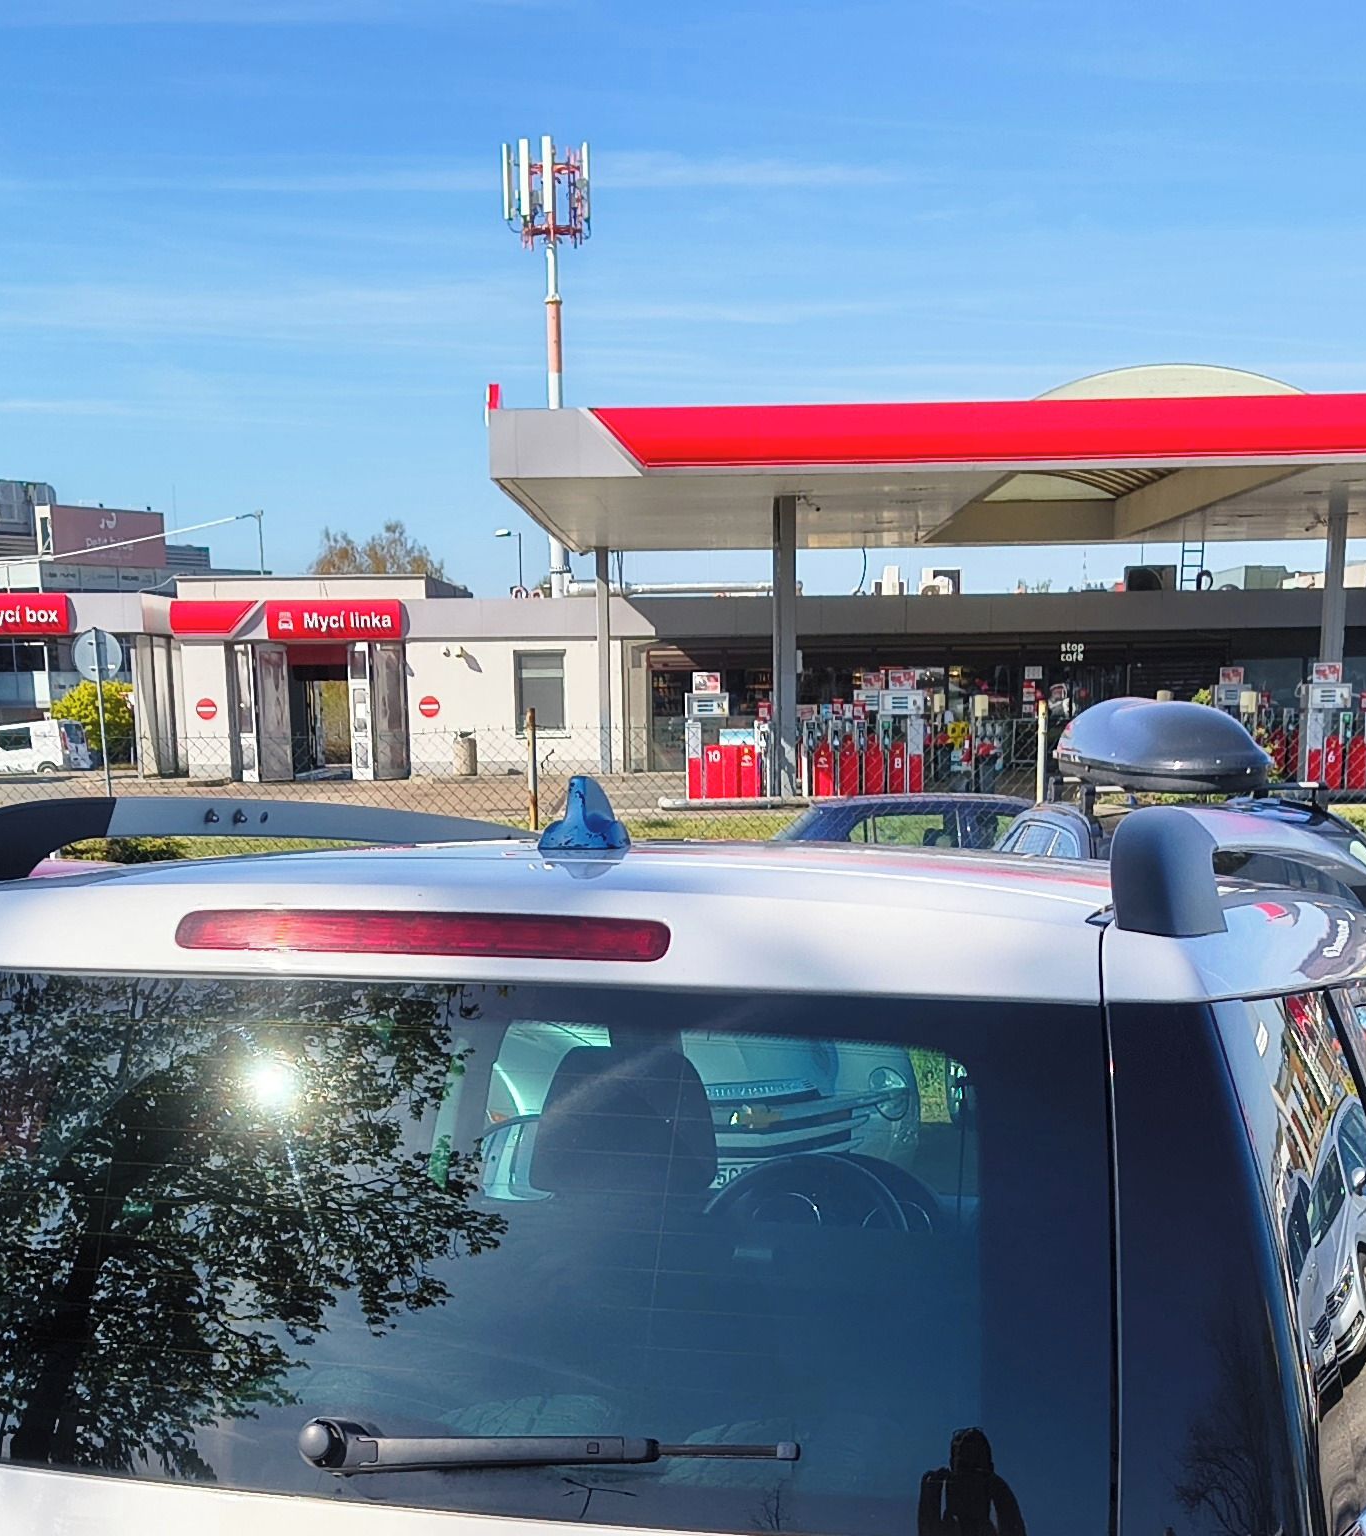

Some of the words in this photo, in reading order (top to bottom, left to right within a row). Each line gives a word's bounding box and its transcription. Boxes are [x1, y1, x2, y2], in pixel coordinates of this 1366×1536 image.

[25, 608, 59, 623] box
[302, 610, 346, 630] Mycí
[348, 611, 392, 629] linka
[1060, 642, 1085, 653] stop
[706, 751, 721, 763] 10
[1327, 751, 1336, 763] 6
